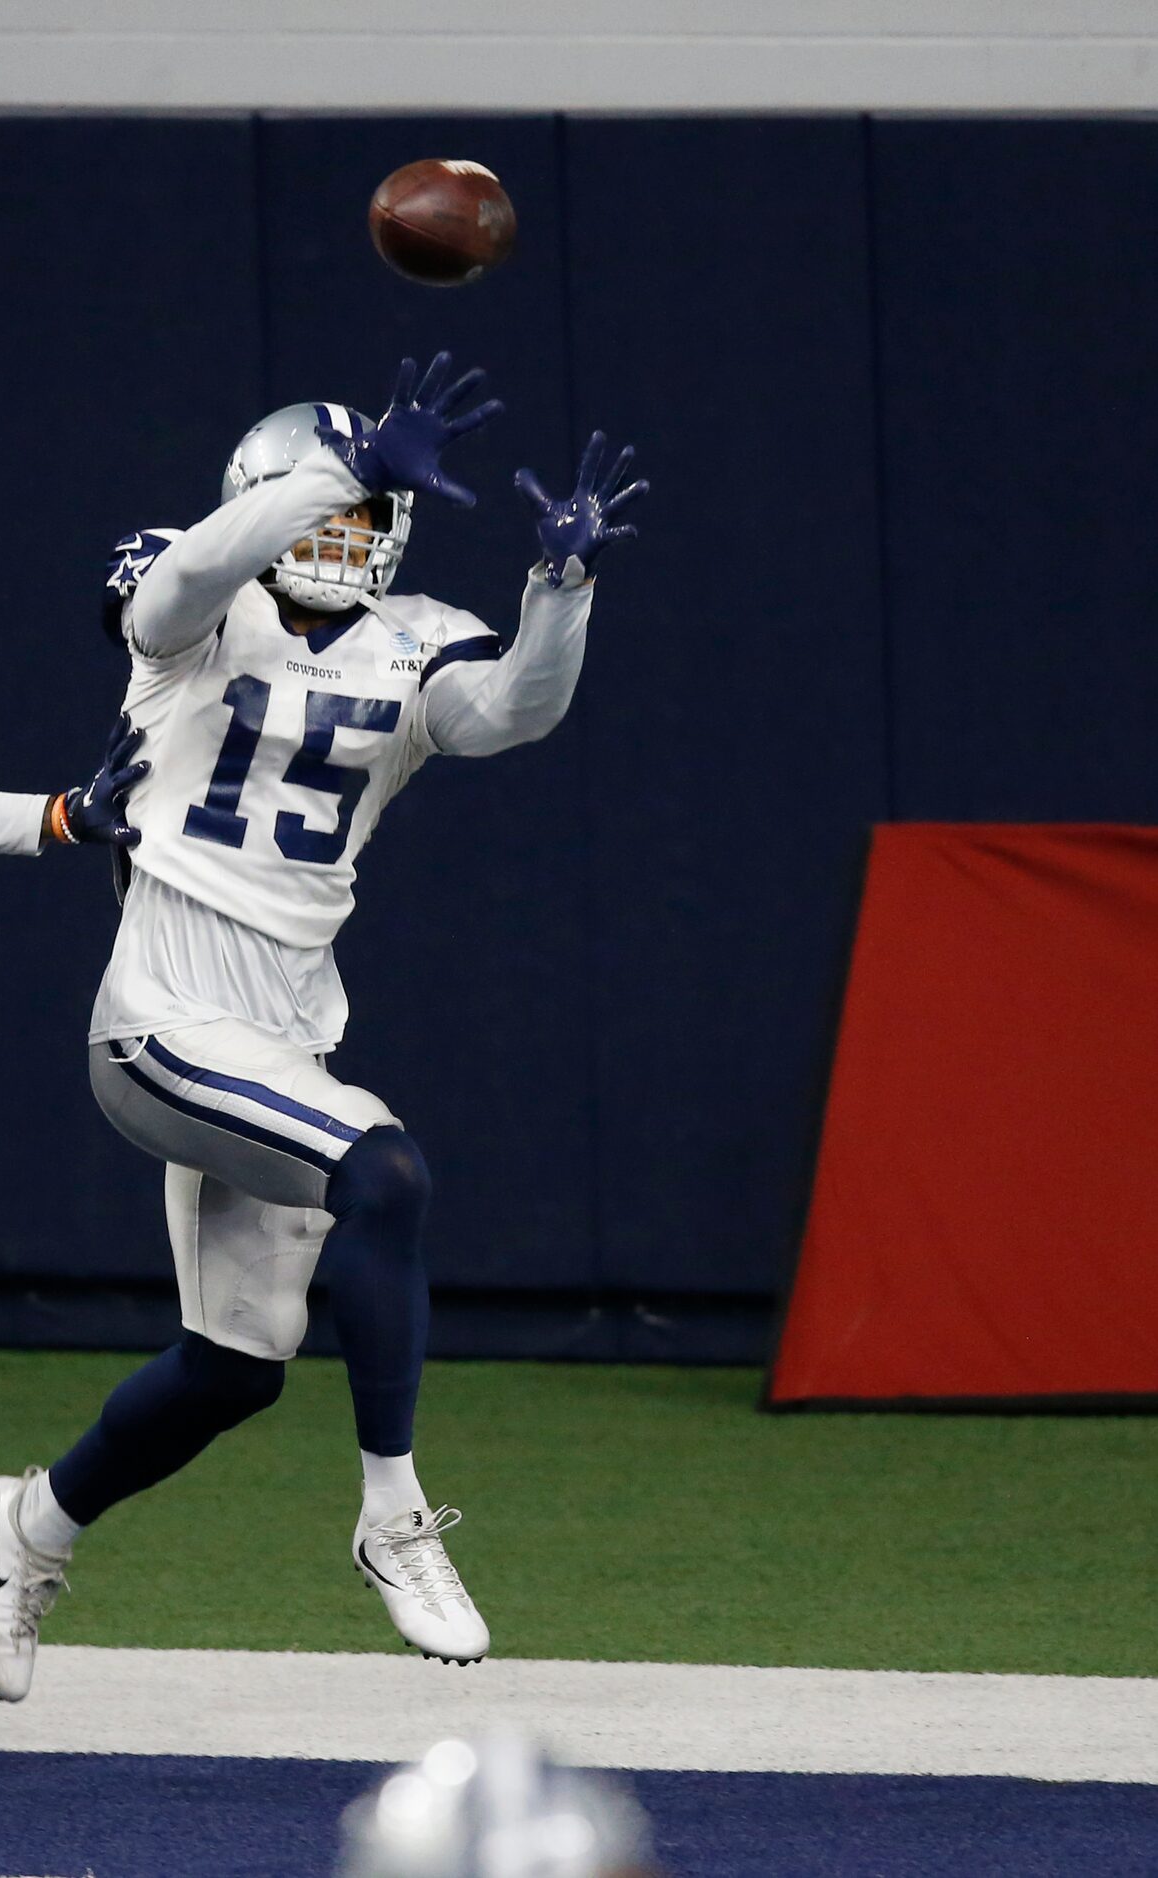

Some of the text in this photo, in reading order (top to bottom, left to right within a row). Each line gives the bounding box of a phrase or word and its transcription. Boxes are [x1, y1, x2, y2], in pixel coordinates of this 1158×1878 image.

[286, 660, 342, 679] COWBOYS
[390, 660, 424, 672] AT&T
[182, 674, 402, 865] 15
[412, 1510, 423, 1527] VPR
